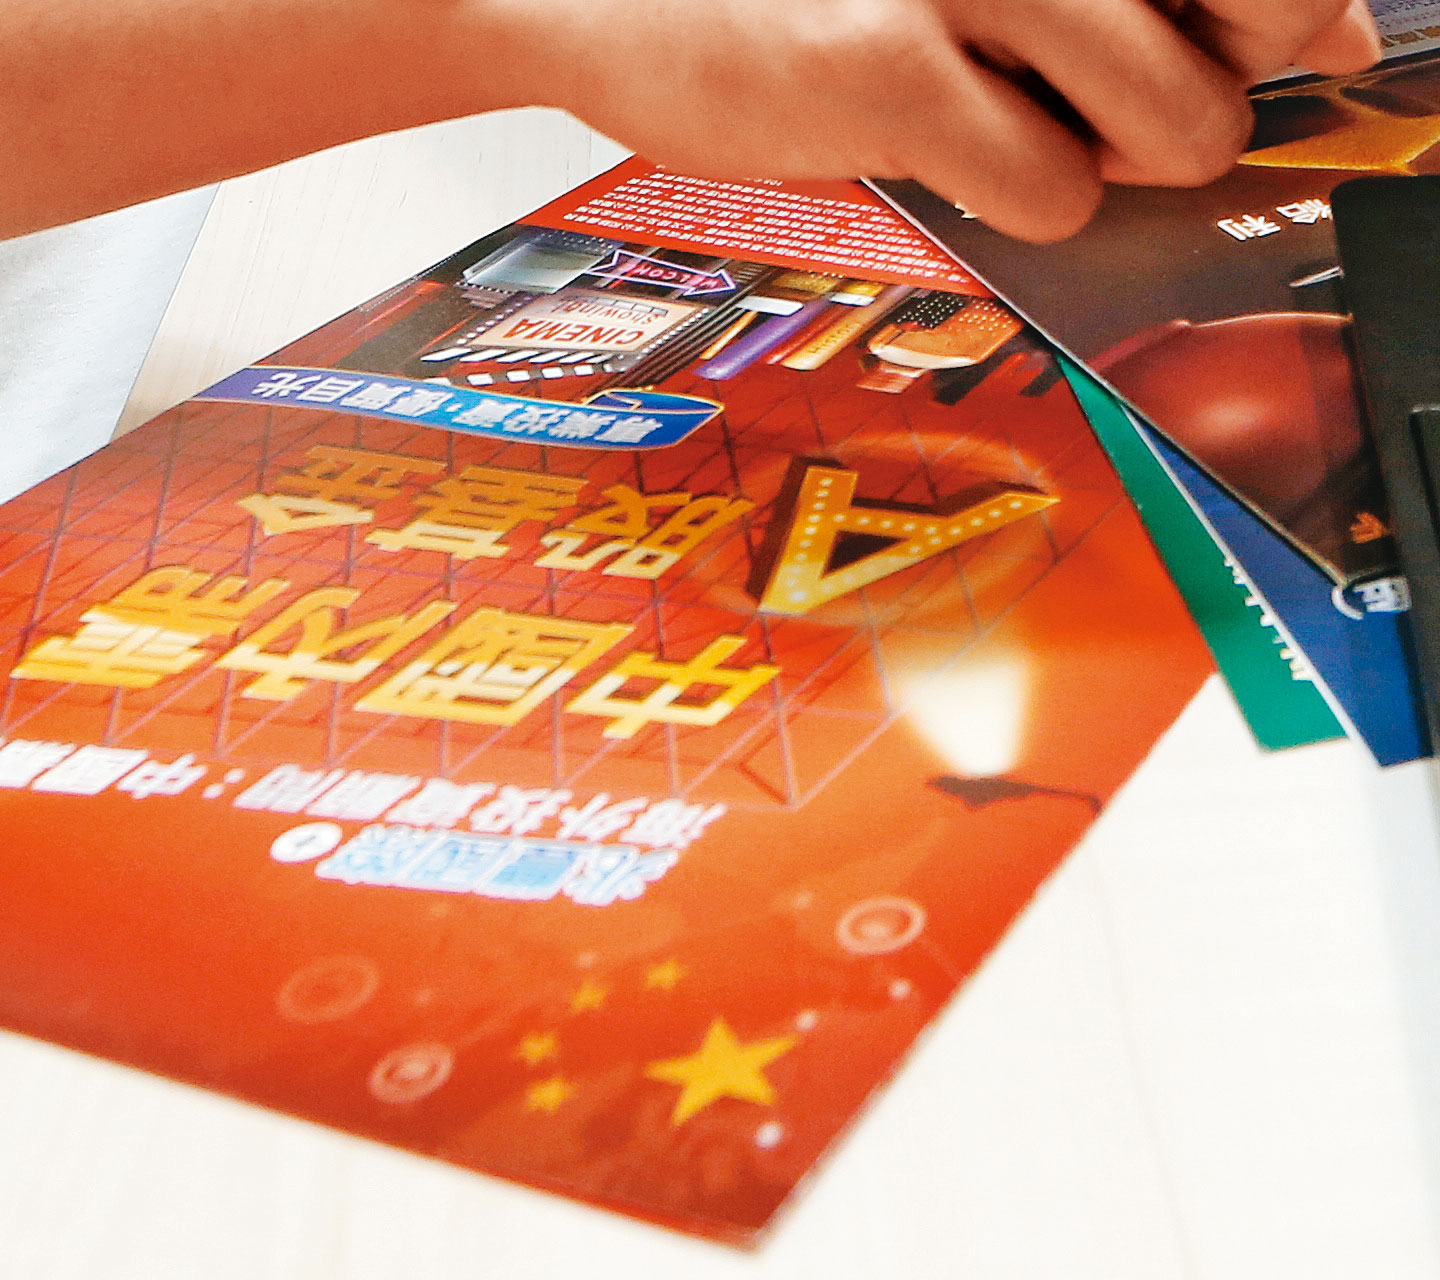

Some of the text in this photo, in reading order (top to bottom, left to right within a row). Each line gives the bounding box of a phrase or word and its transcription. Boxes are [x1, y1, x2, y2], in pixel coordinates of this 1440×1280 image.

[502, 316, 646, 347] CINEMA
[11, 566, 780, 740] 中國內需
